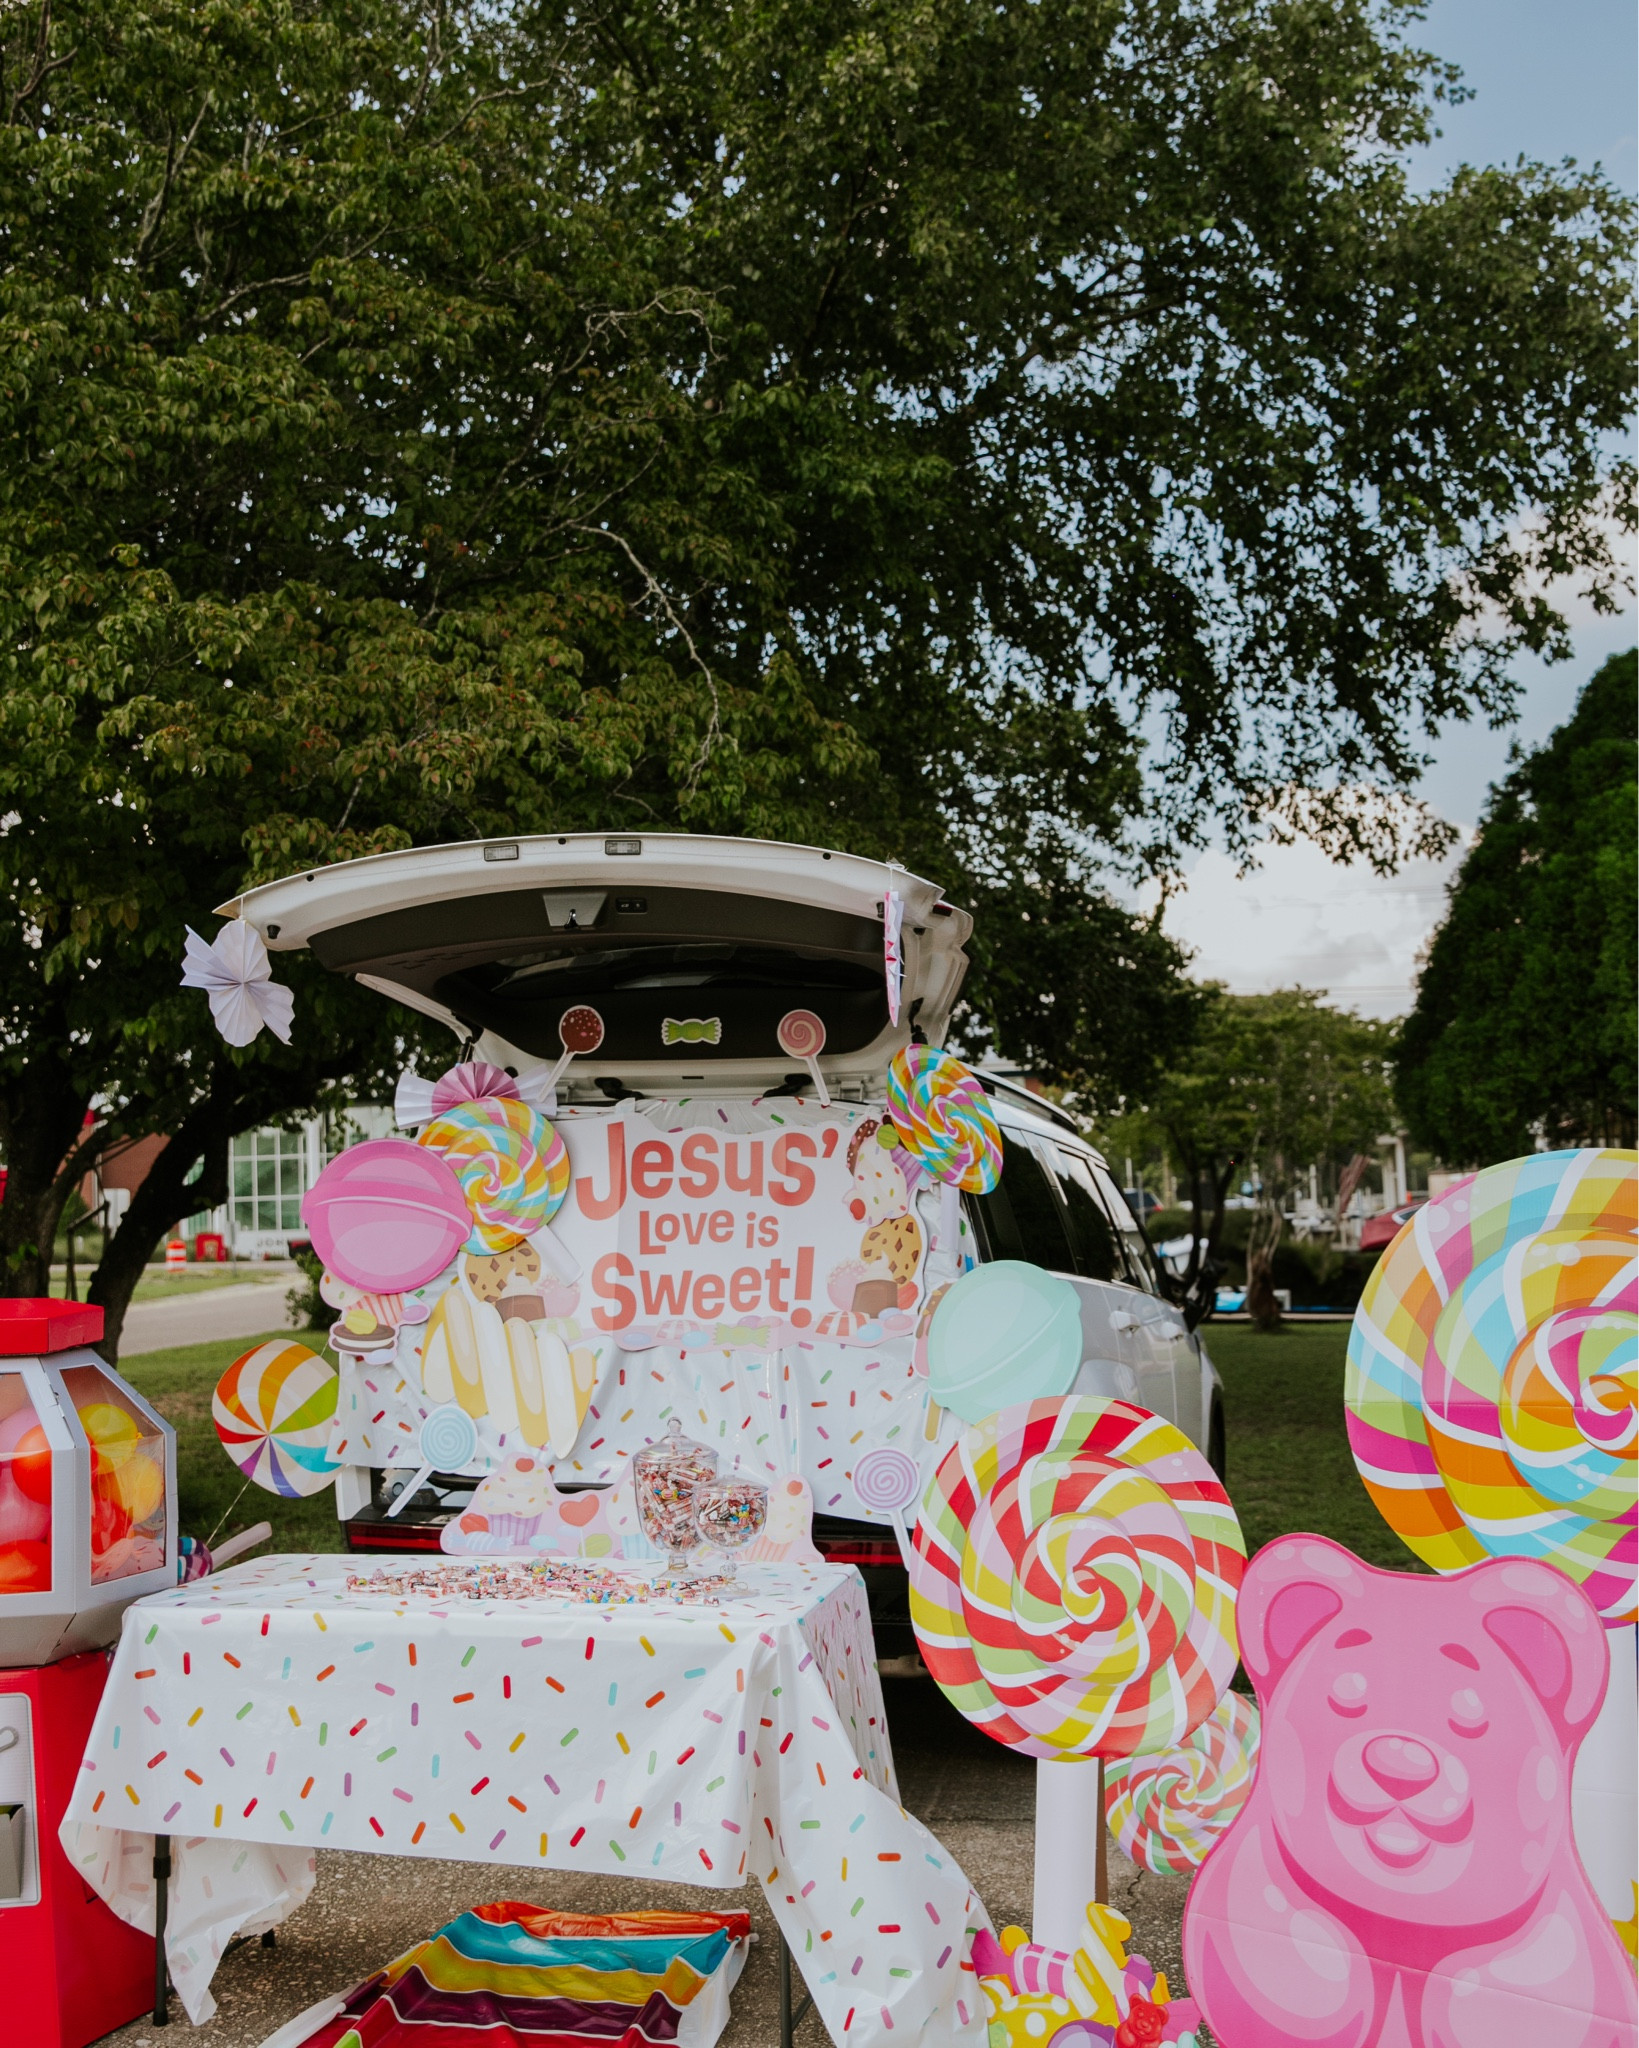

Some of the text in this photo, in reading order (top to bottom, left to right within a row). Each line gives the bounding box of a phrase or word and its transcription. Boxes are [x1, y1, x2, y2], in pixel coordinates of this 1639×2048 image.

[575, 1121, 839, 1221] Jesus'
[639, 1210, 779, 1255] Love is
[591, 1246, 815, 1331] Sweet!
